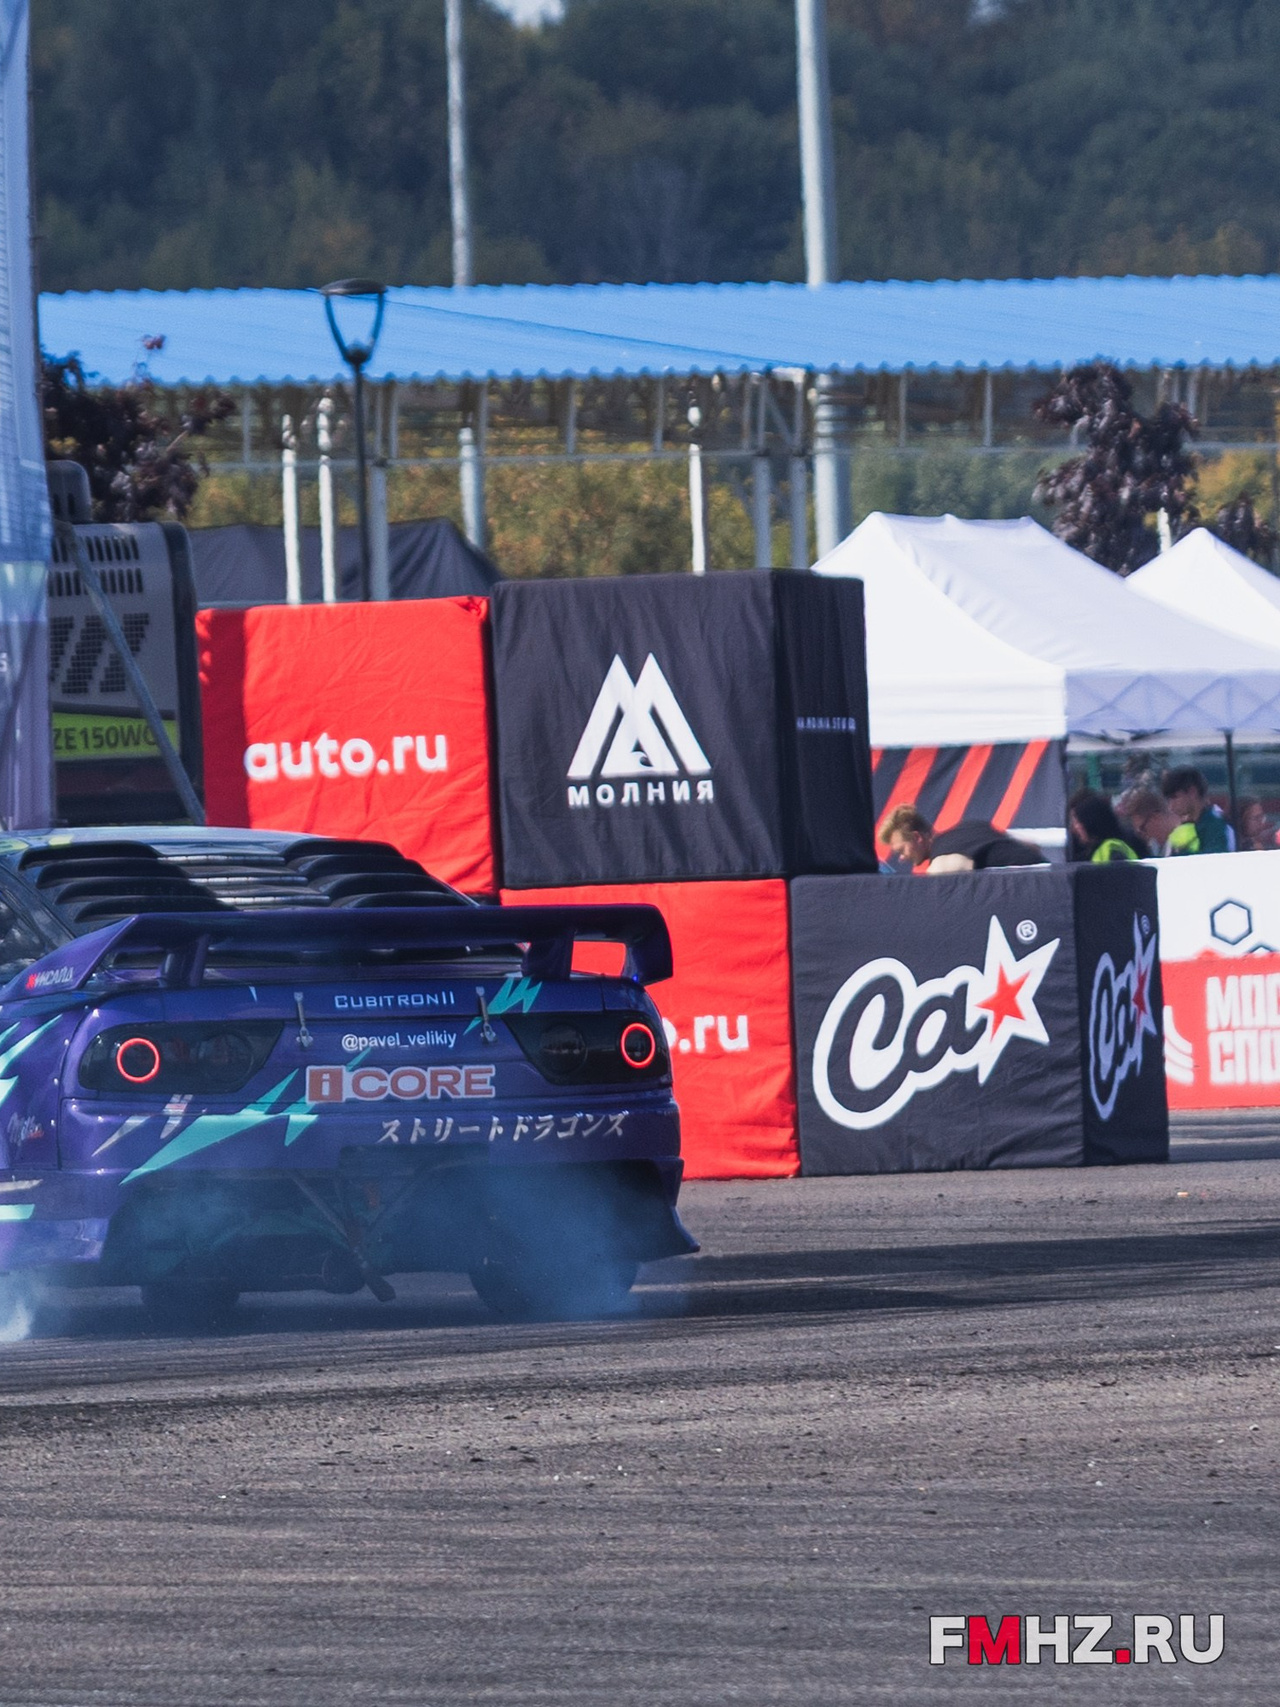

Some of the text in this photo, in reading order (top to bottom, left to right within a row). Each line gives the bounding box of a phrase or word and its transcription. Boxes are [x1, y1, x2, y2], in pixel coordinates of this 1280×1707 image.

[245, 733, 449, 782] auto.ru
[567, 779, 716, 809] МОЛНИЯ
[341, 1031, 457, 1051] @pavel_velikiy
[376, 1109, 630, 1144] ストリートドラゴンズ
